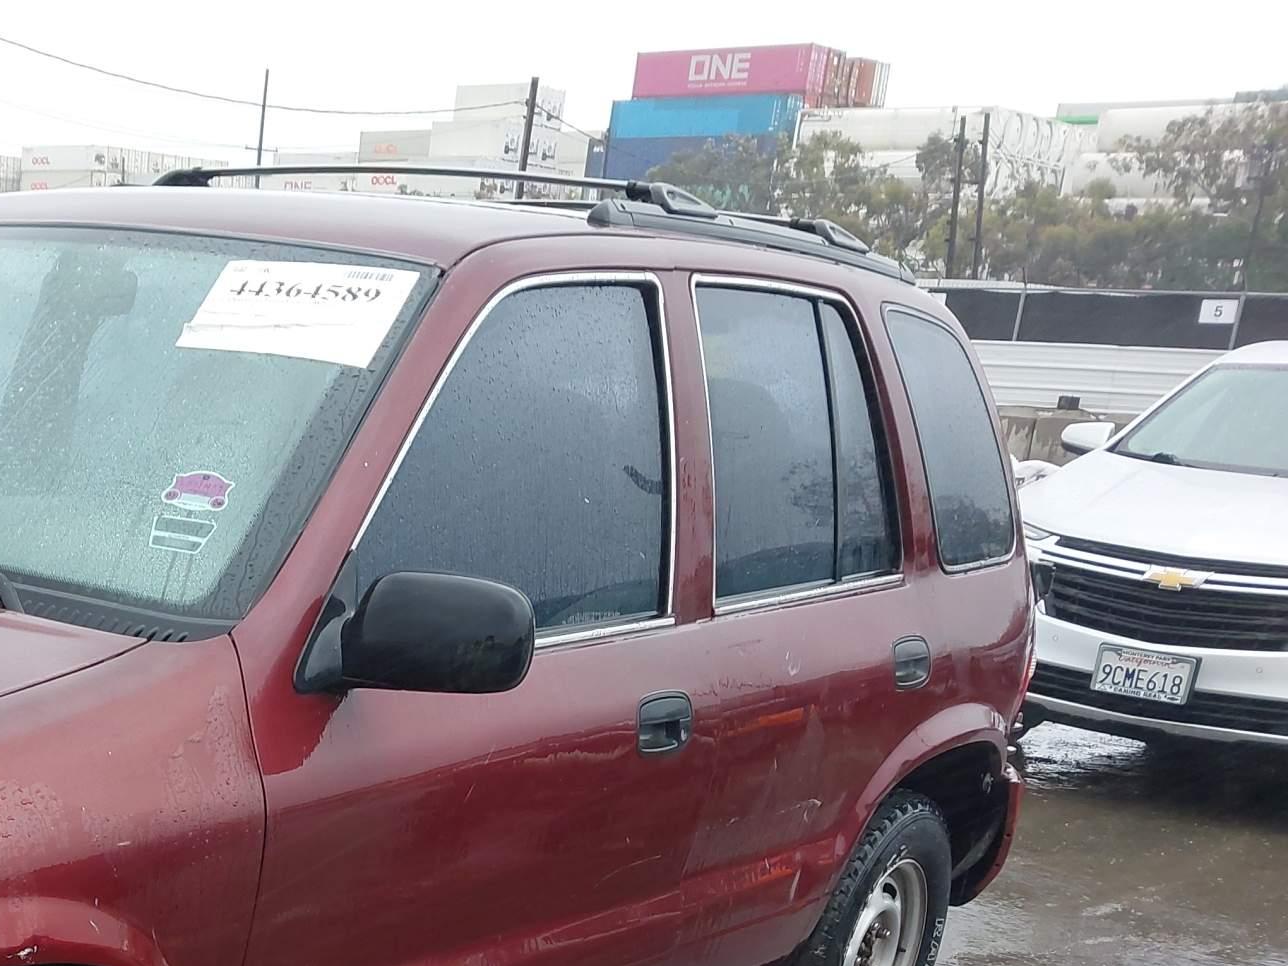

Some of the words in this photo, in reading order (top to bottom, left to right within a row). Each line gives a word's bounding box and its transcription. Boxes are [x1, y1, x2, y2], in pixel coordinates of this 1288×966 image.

[688, 53, 752, 81] ONE
[371, 174, 397, 186] OOCL
[229, 279, 381, 303] 44364589
[1214, 305, 1223, 318] 5
[1099, 663, 1183, 696] 9CME618
